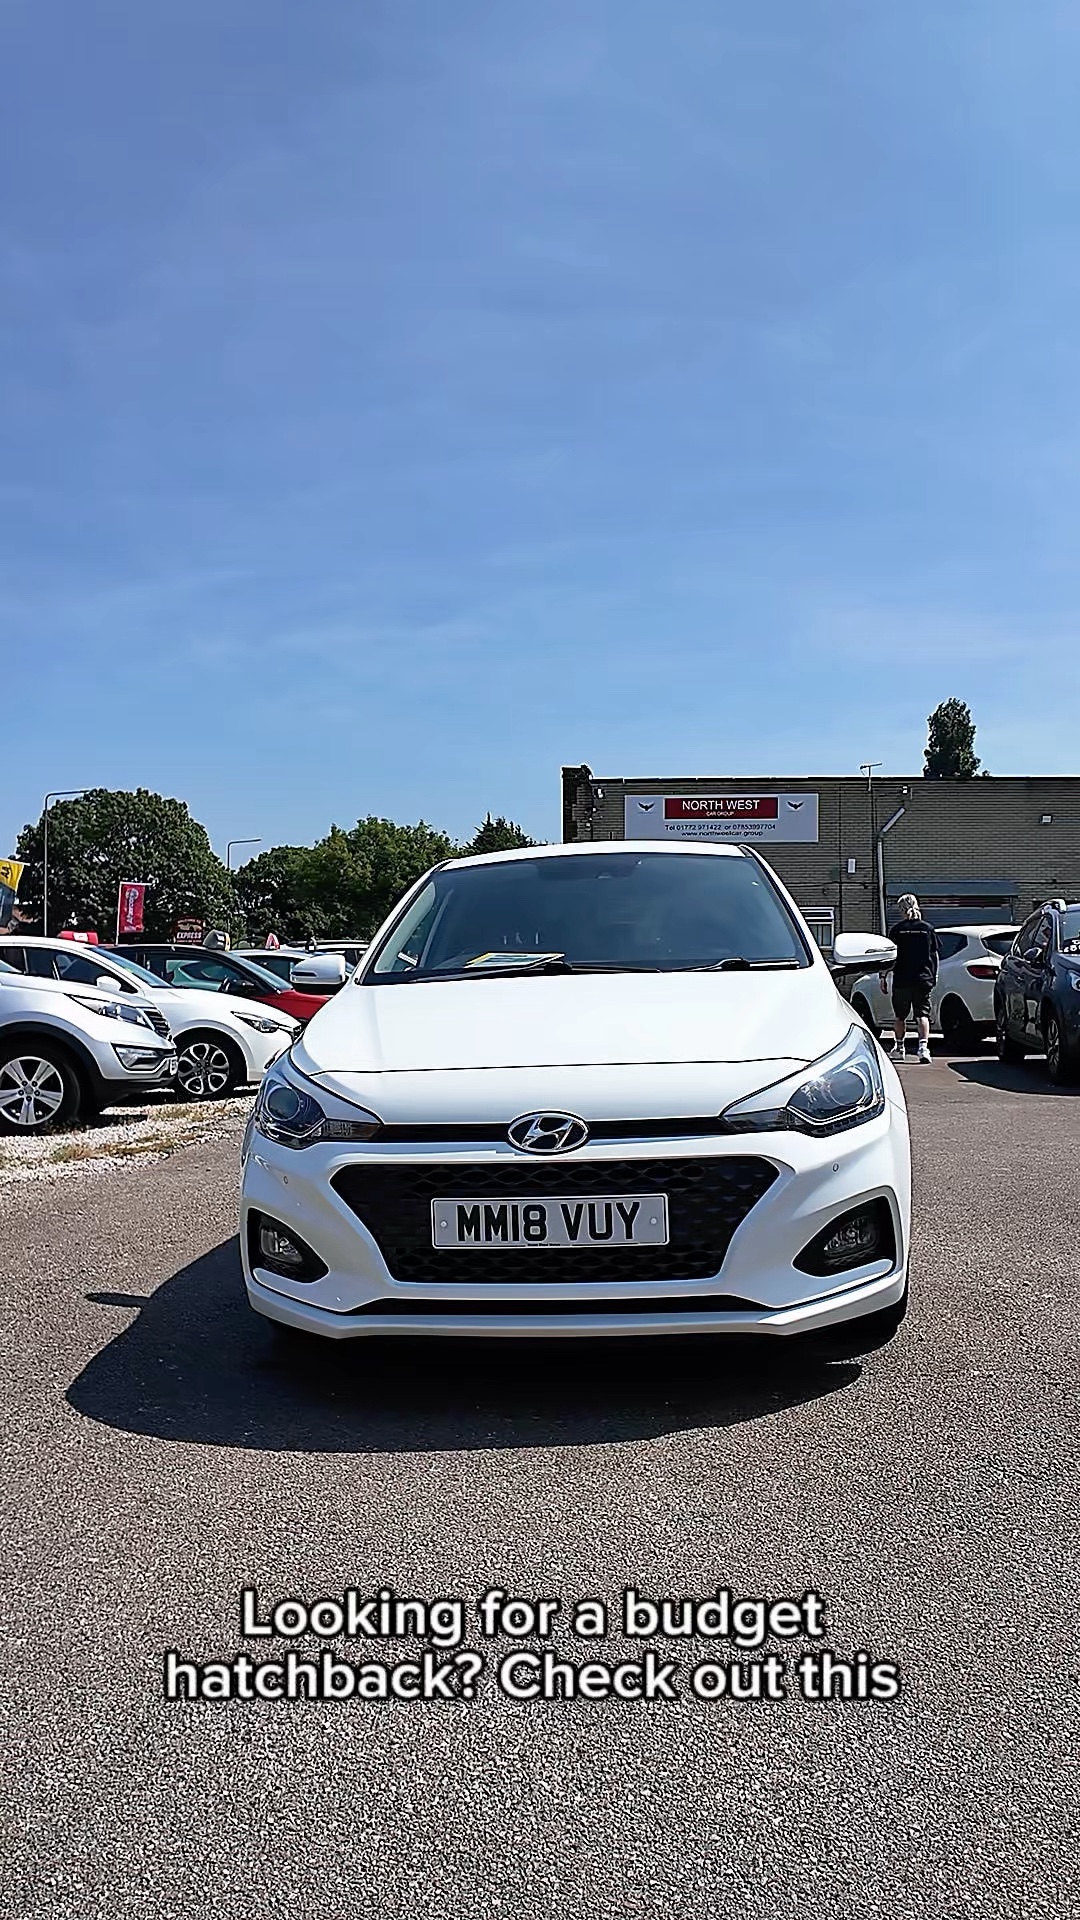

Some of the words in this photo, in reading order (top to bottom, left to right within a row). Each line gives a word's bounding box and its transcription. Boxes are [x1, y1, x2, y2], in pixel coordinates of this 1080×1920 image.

[682, 799, 723, 810] NORTH
[726, 799, 760, 810] WEST
[456, 1203, 548, 1242] MM18
[560, 1201, 641, 1241] VUY
